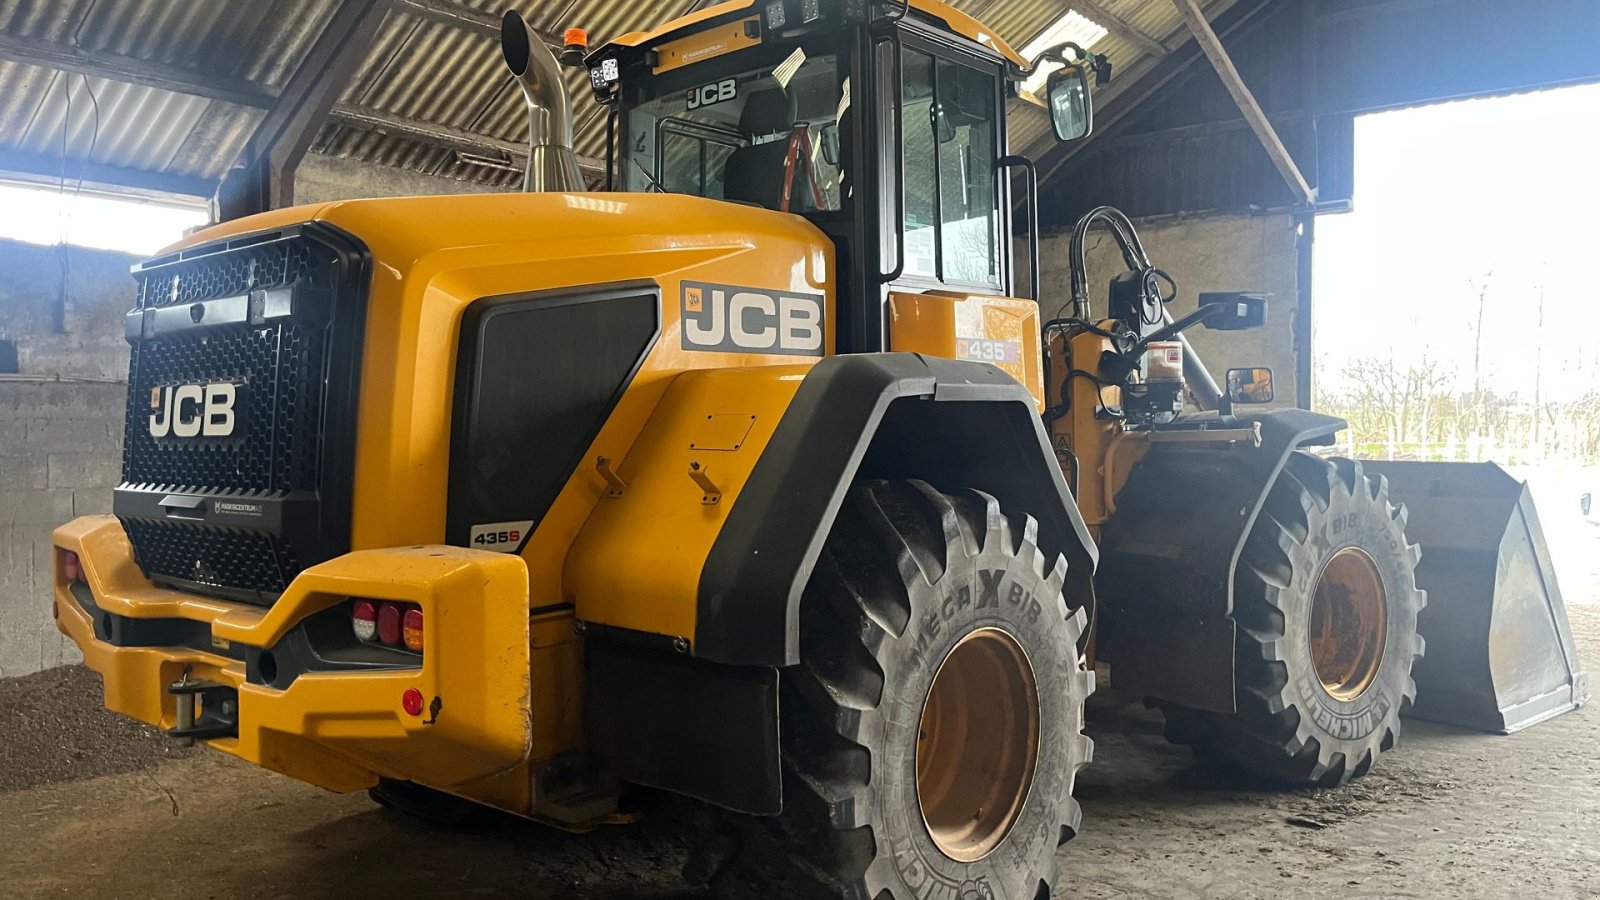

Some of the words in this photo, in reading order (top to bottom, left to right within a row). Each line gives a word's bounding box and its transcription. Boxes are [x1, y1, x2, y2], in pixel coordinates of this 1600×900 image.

[687, 80, 737, 109] JCB
[685, 289, 822, 350] JCB
[150, 383, 235, 437] JCB
[474, 530, 520, 545] 435S
[1333, 512, 1358, 537] BIB
[909, 584, 971, 666] MEGA
[1007, 581, 1042, 624] BIB
